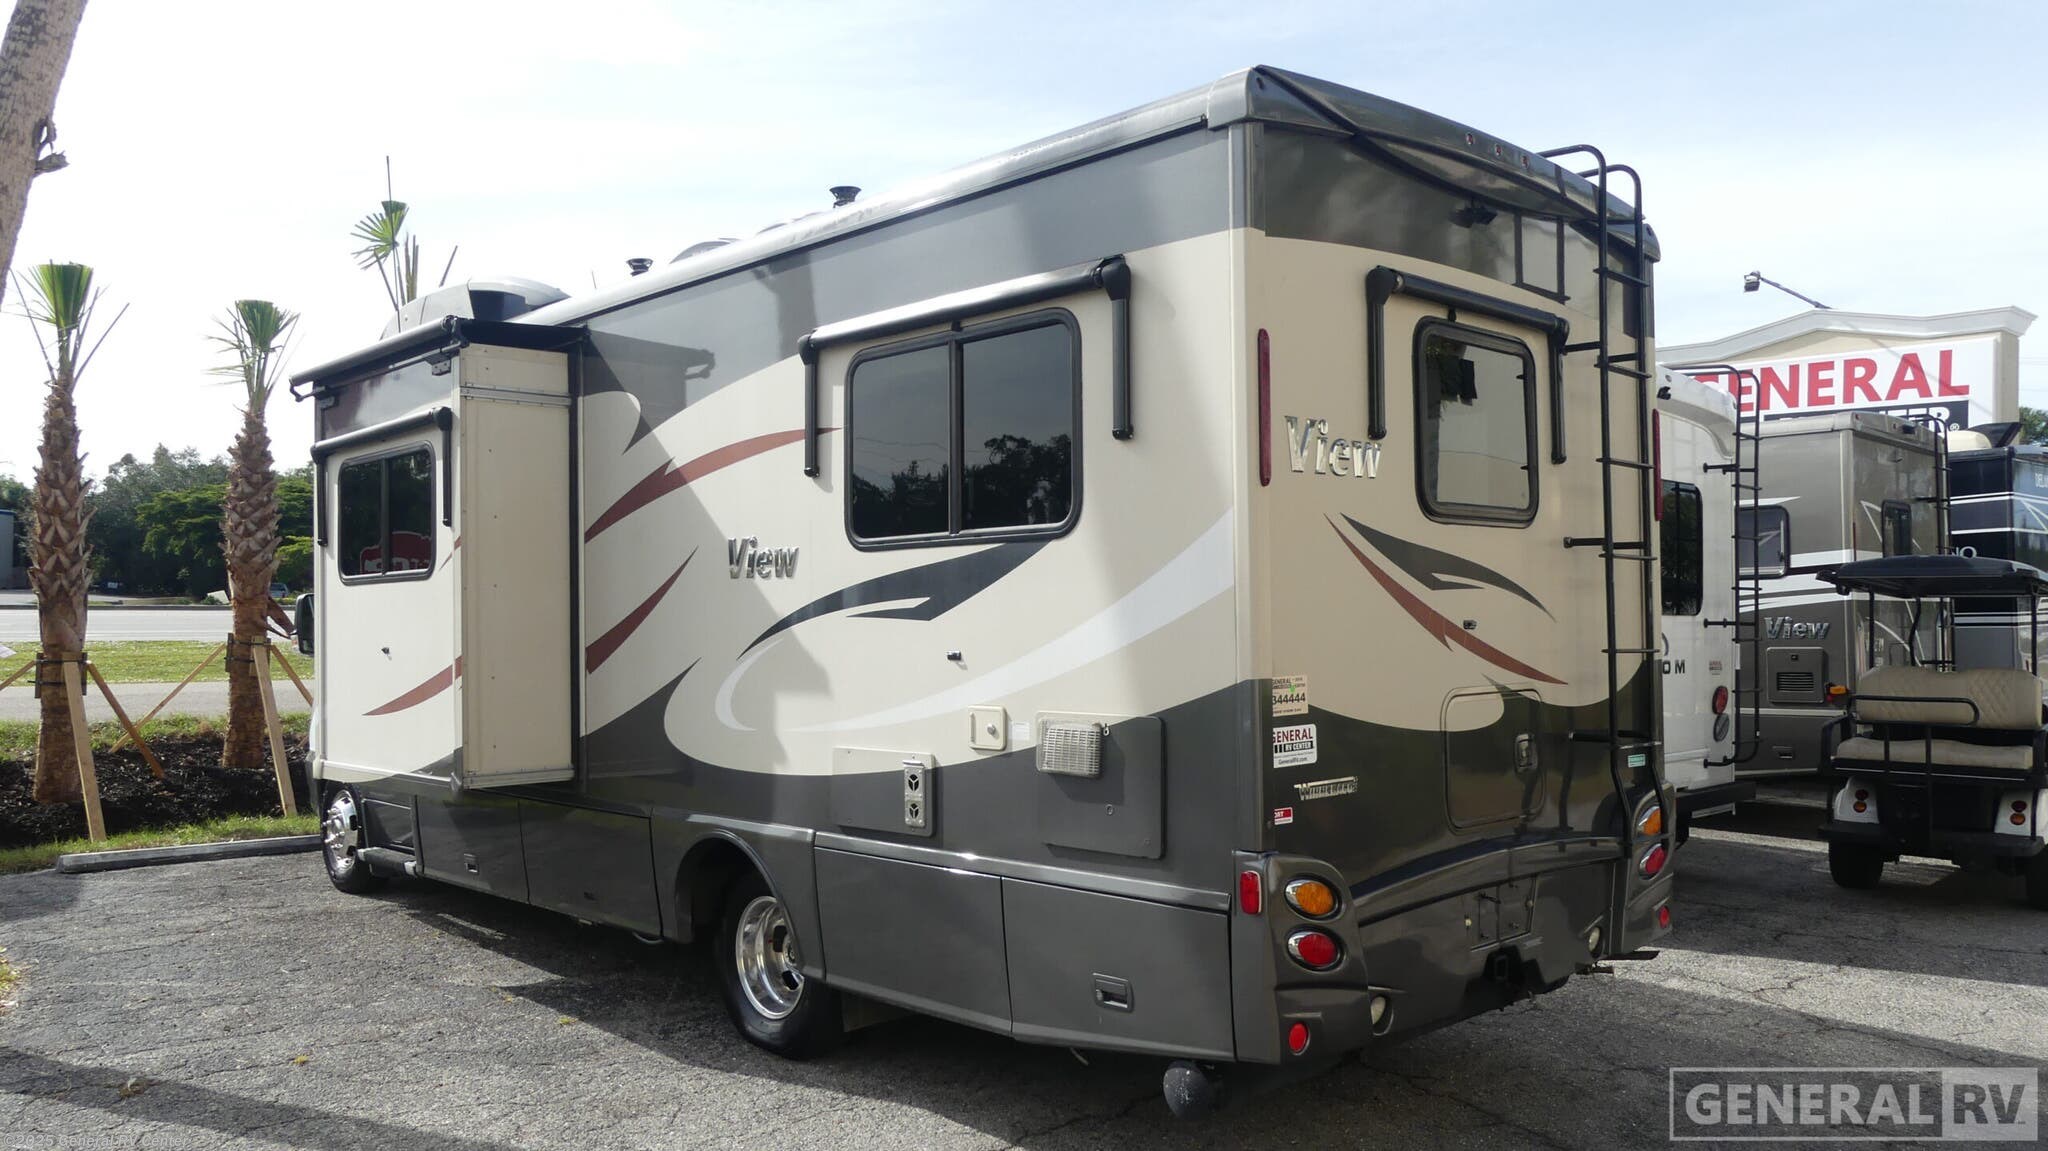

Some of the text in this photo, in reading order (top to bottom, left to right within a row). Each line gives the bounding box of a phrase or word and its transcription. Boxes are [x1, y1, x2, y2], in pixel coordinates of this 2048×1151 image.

[1284, 415, 1382, 479] View
[728, 536, 799, 579] View
[1764, 616, 1832, 640] View
